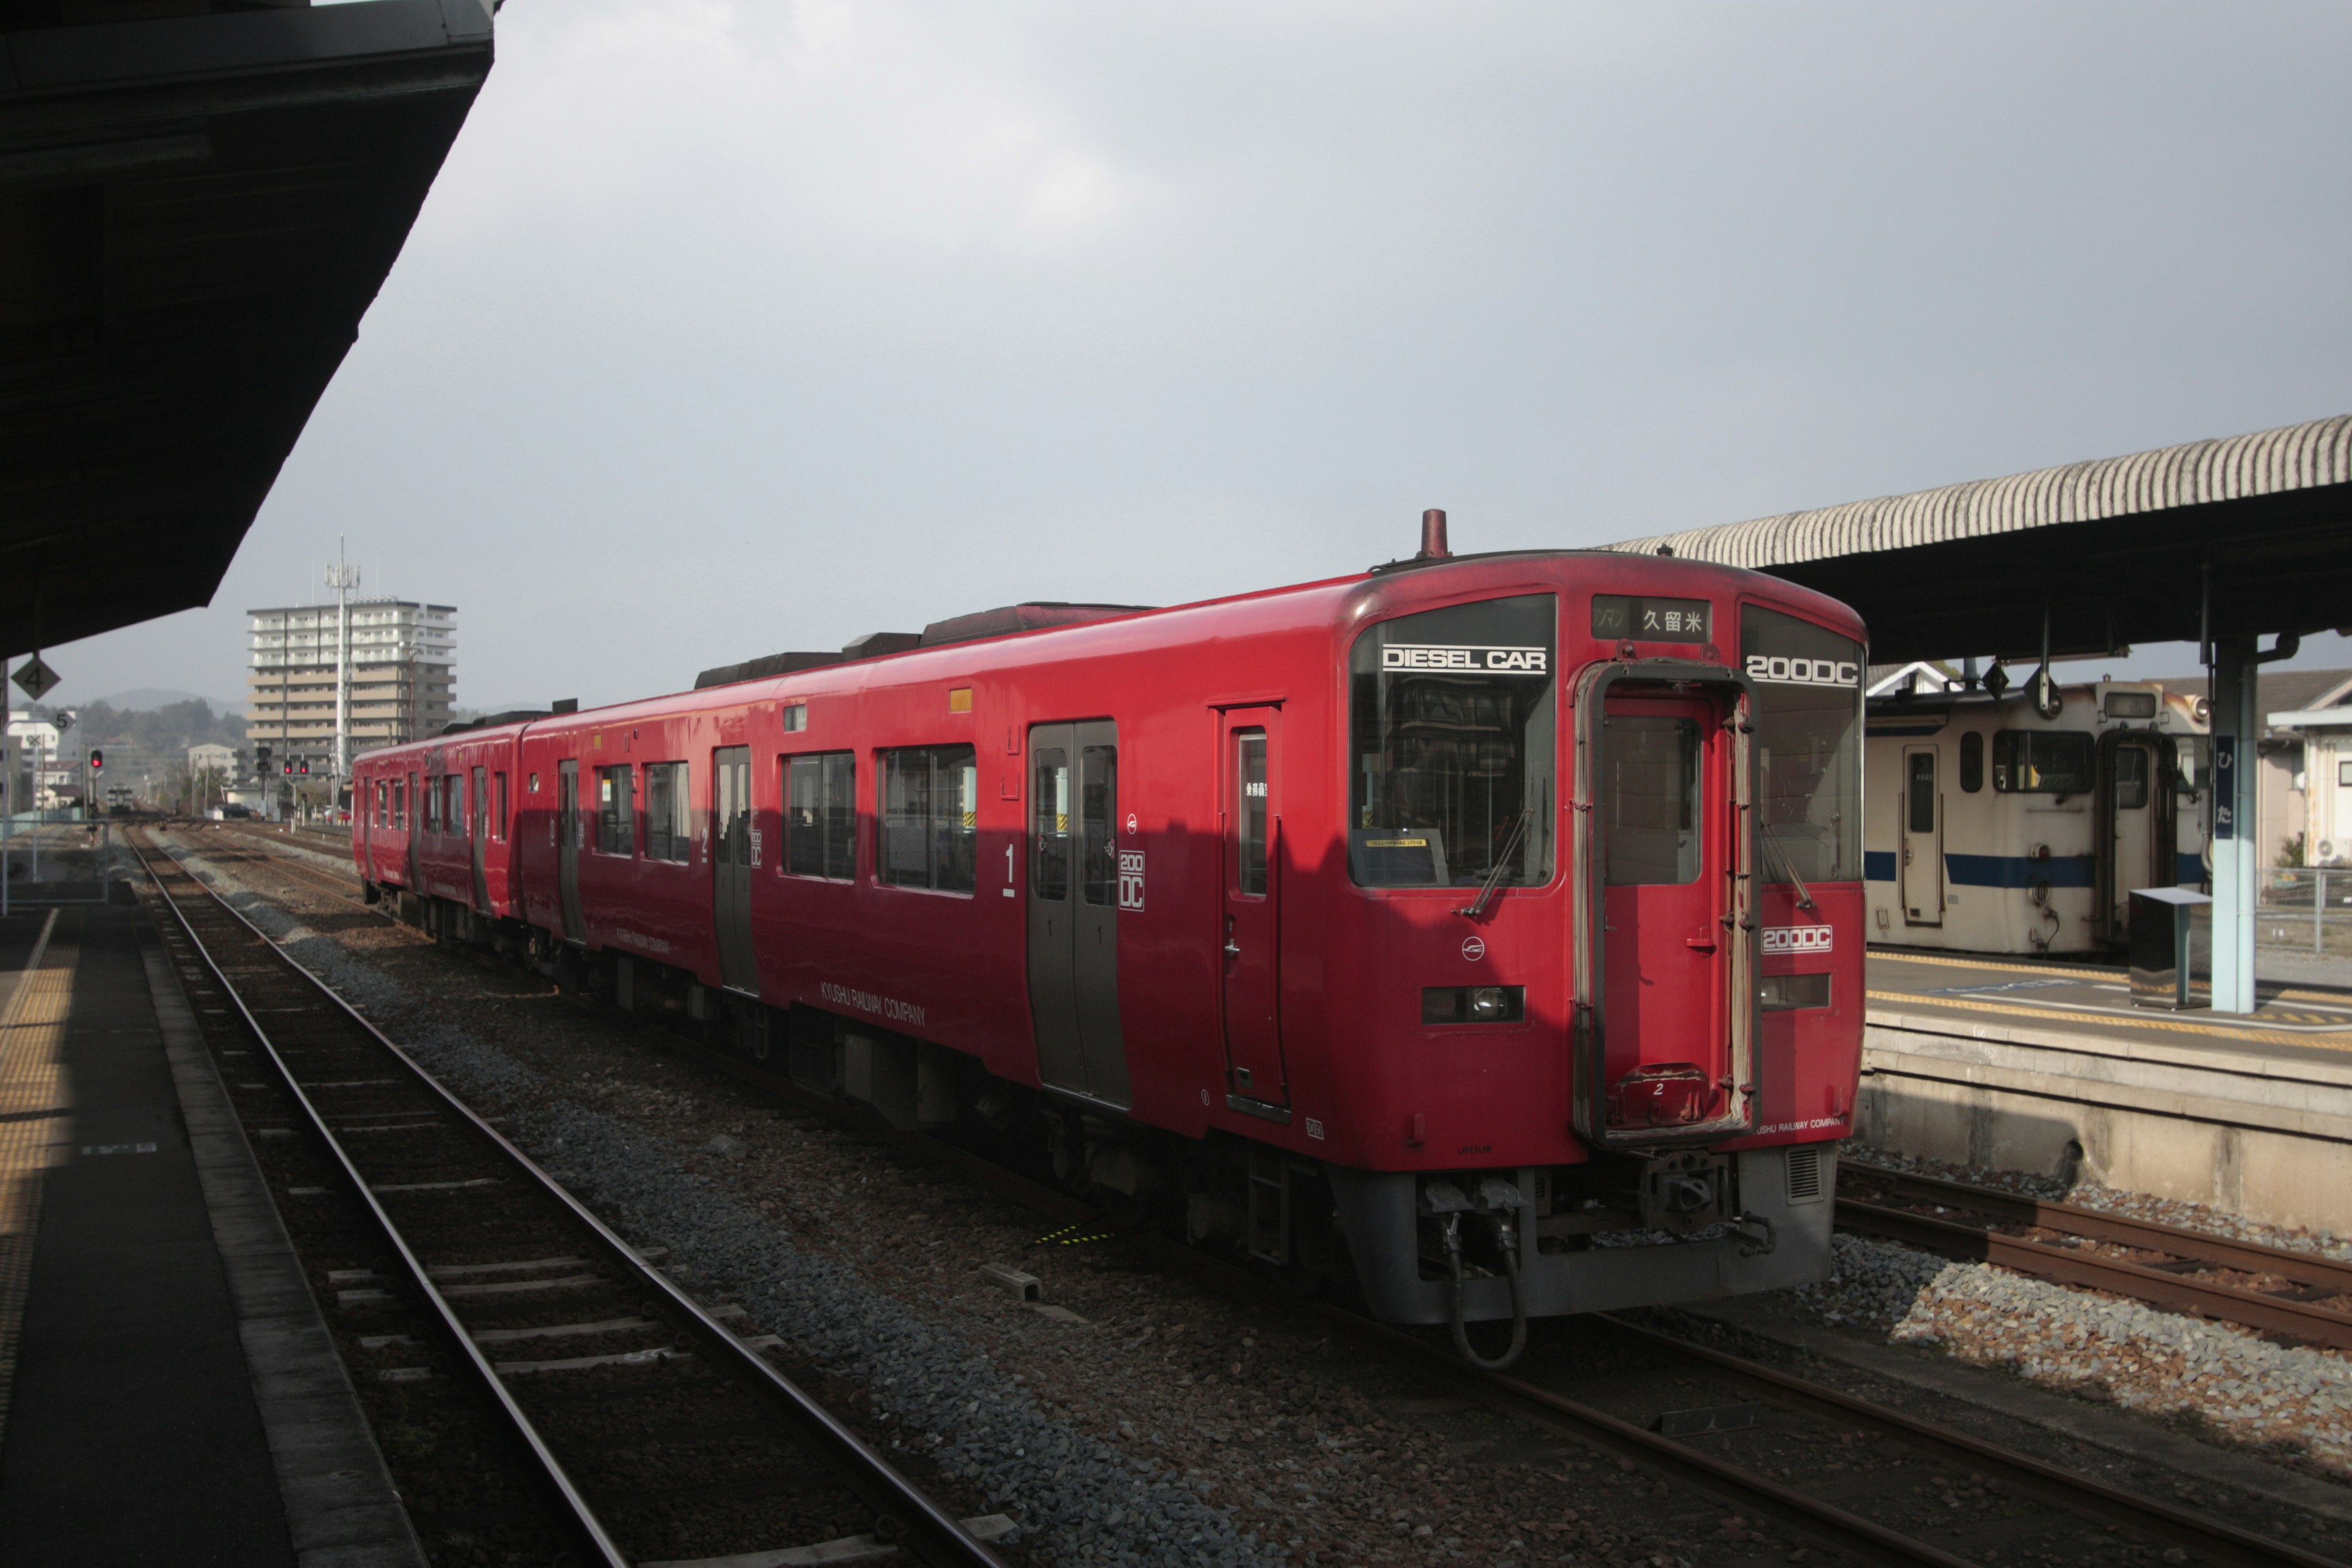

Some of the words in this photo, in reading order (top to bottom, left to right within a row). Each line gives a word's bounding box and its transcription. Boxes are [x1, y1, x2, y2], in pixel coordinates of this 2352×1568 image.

[1593, 608, 1623, 628] ンマン
[1643, 609, 1702, 633] 久留米
[1383, 649, 1480, 668] DIESEL
[1487, 650, 1546, 669] CAR
[25, 666, 45, 691] 4
[1746, 655, 1858, 684] 200DC
[56, 714, 67, 728] 5
[2217, 751, 2233, 824] ひた
[551, 819, 555, 840] 3
[701, 827, 708, 854] 2
[752, 846, 761, 866] DC
[1005, 843, 1013, 883] 1
[1120, 854, 1144, 872] 200
[1120, 875, 1143, 908] DC
[1047, 918, 1052, 938] 1
[1097, 925, 1102, 945] 1
[1763, 928, 1830, 948] 200DC
[820, 980, 851, 1006] KYUSHU
[851, 988, 882, 1015] RAILWAY
[884, 997, 925, 1027] COMPANY
[1653, 1082, 1664, 1096] 2
[1778, 1120, 1809, 1132] RAILWAY
[1809, 1117, 1845, 1129] COMPANY
